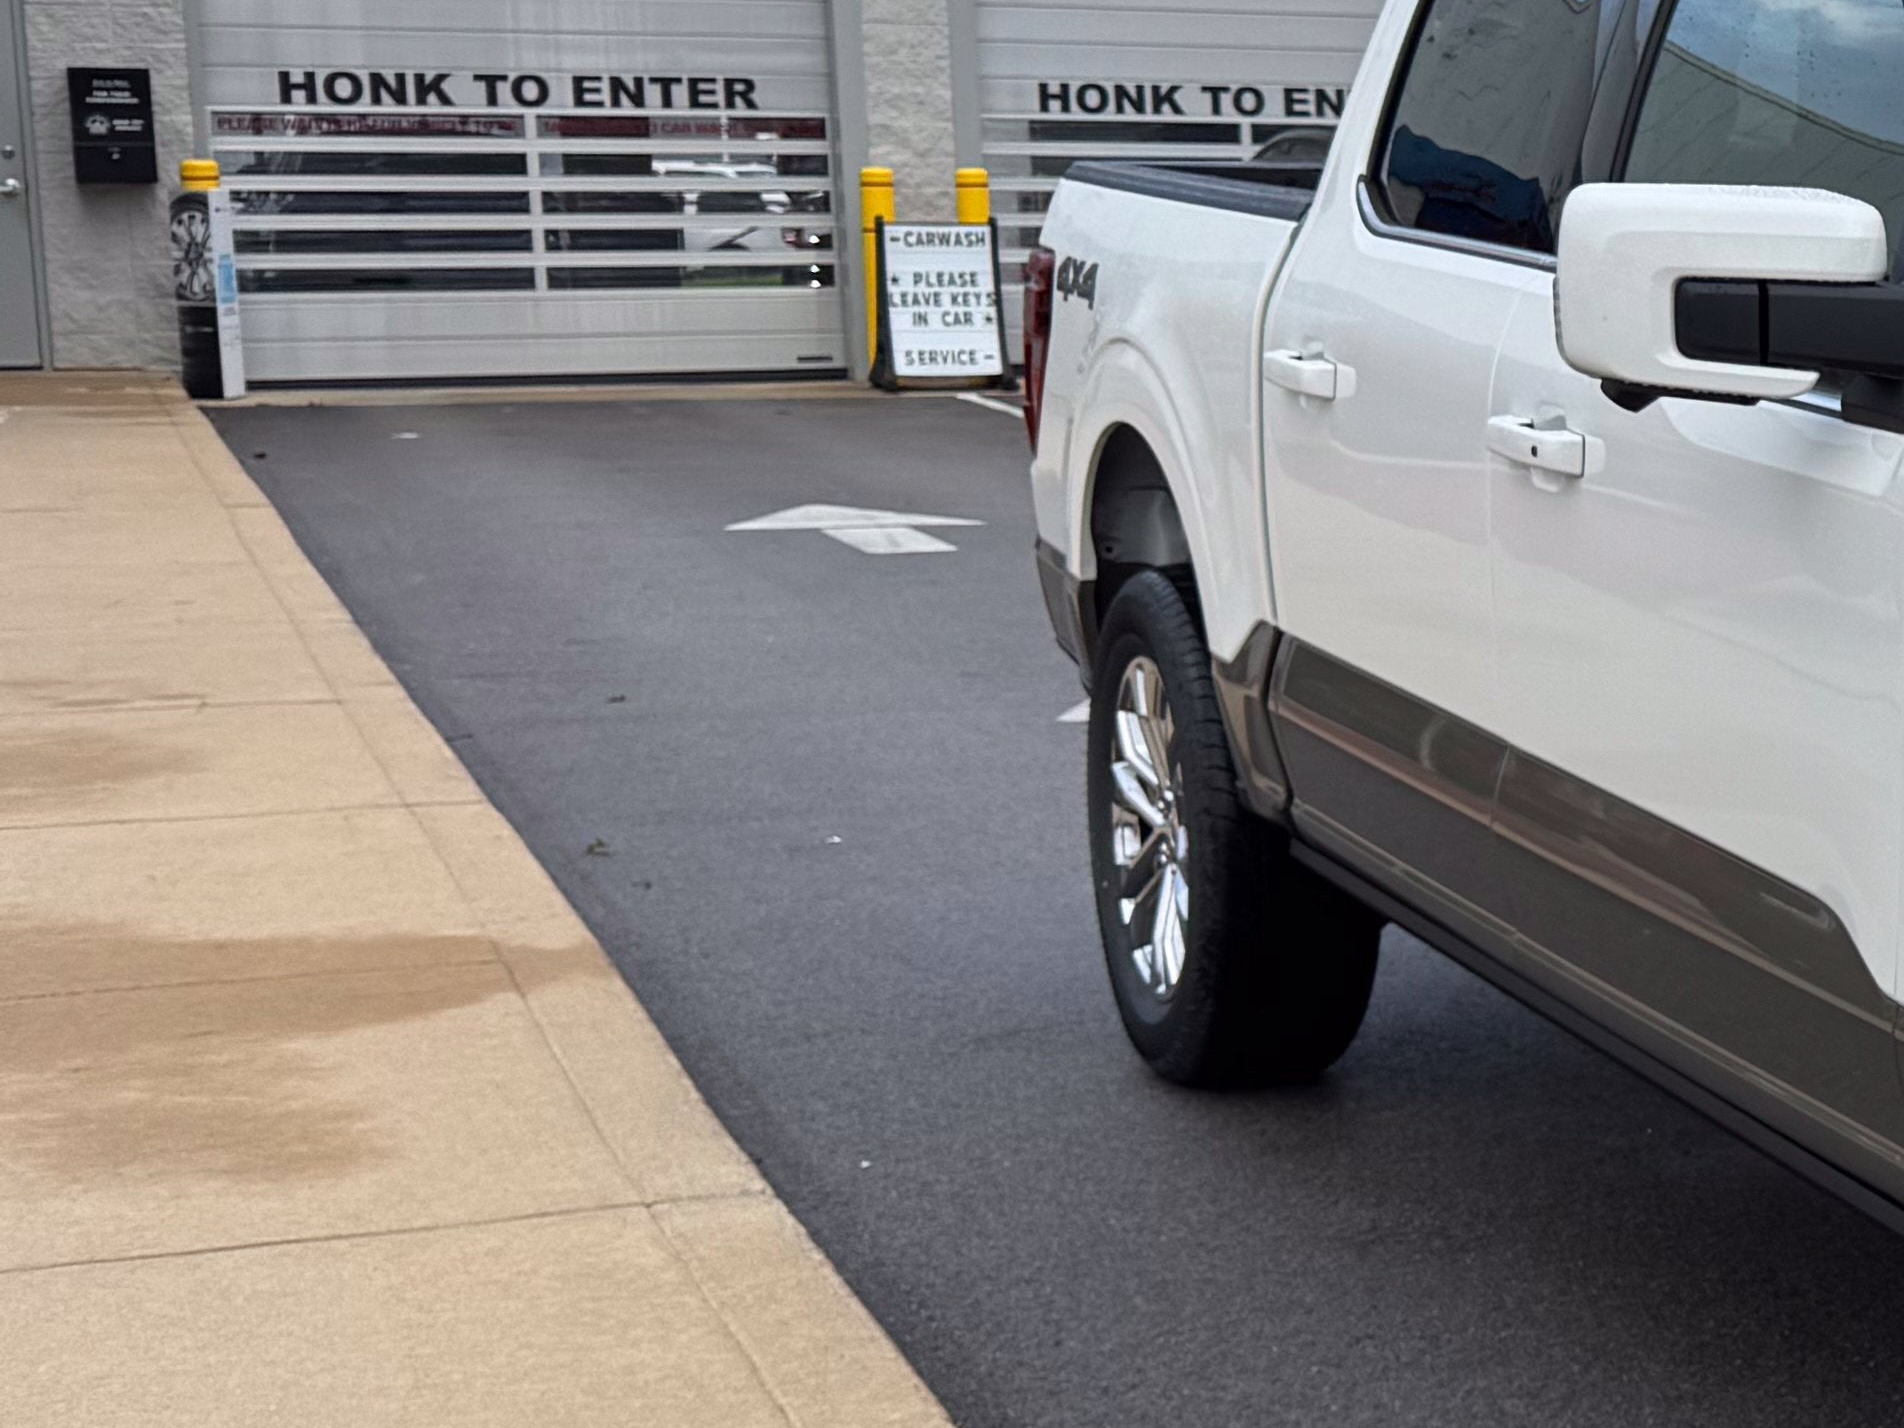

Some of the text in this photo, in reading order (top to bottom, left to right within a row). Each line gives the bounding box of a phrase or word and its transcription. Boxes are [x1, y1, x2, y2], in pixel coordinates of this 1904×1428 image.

[277, 70, 759, 110] HONK TO ENTER
[1038, 82, 1350, 118] HONK TO EN
[913, 271, 978, 288] PLEASE
[889, 291, 997, 308] LEAVE KEYS
[913, 310, 975, 327] IN CAR
[904, 350, 979, 366] SERVICE
